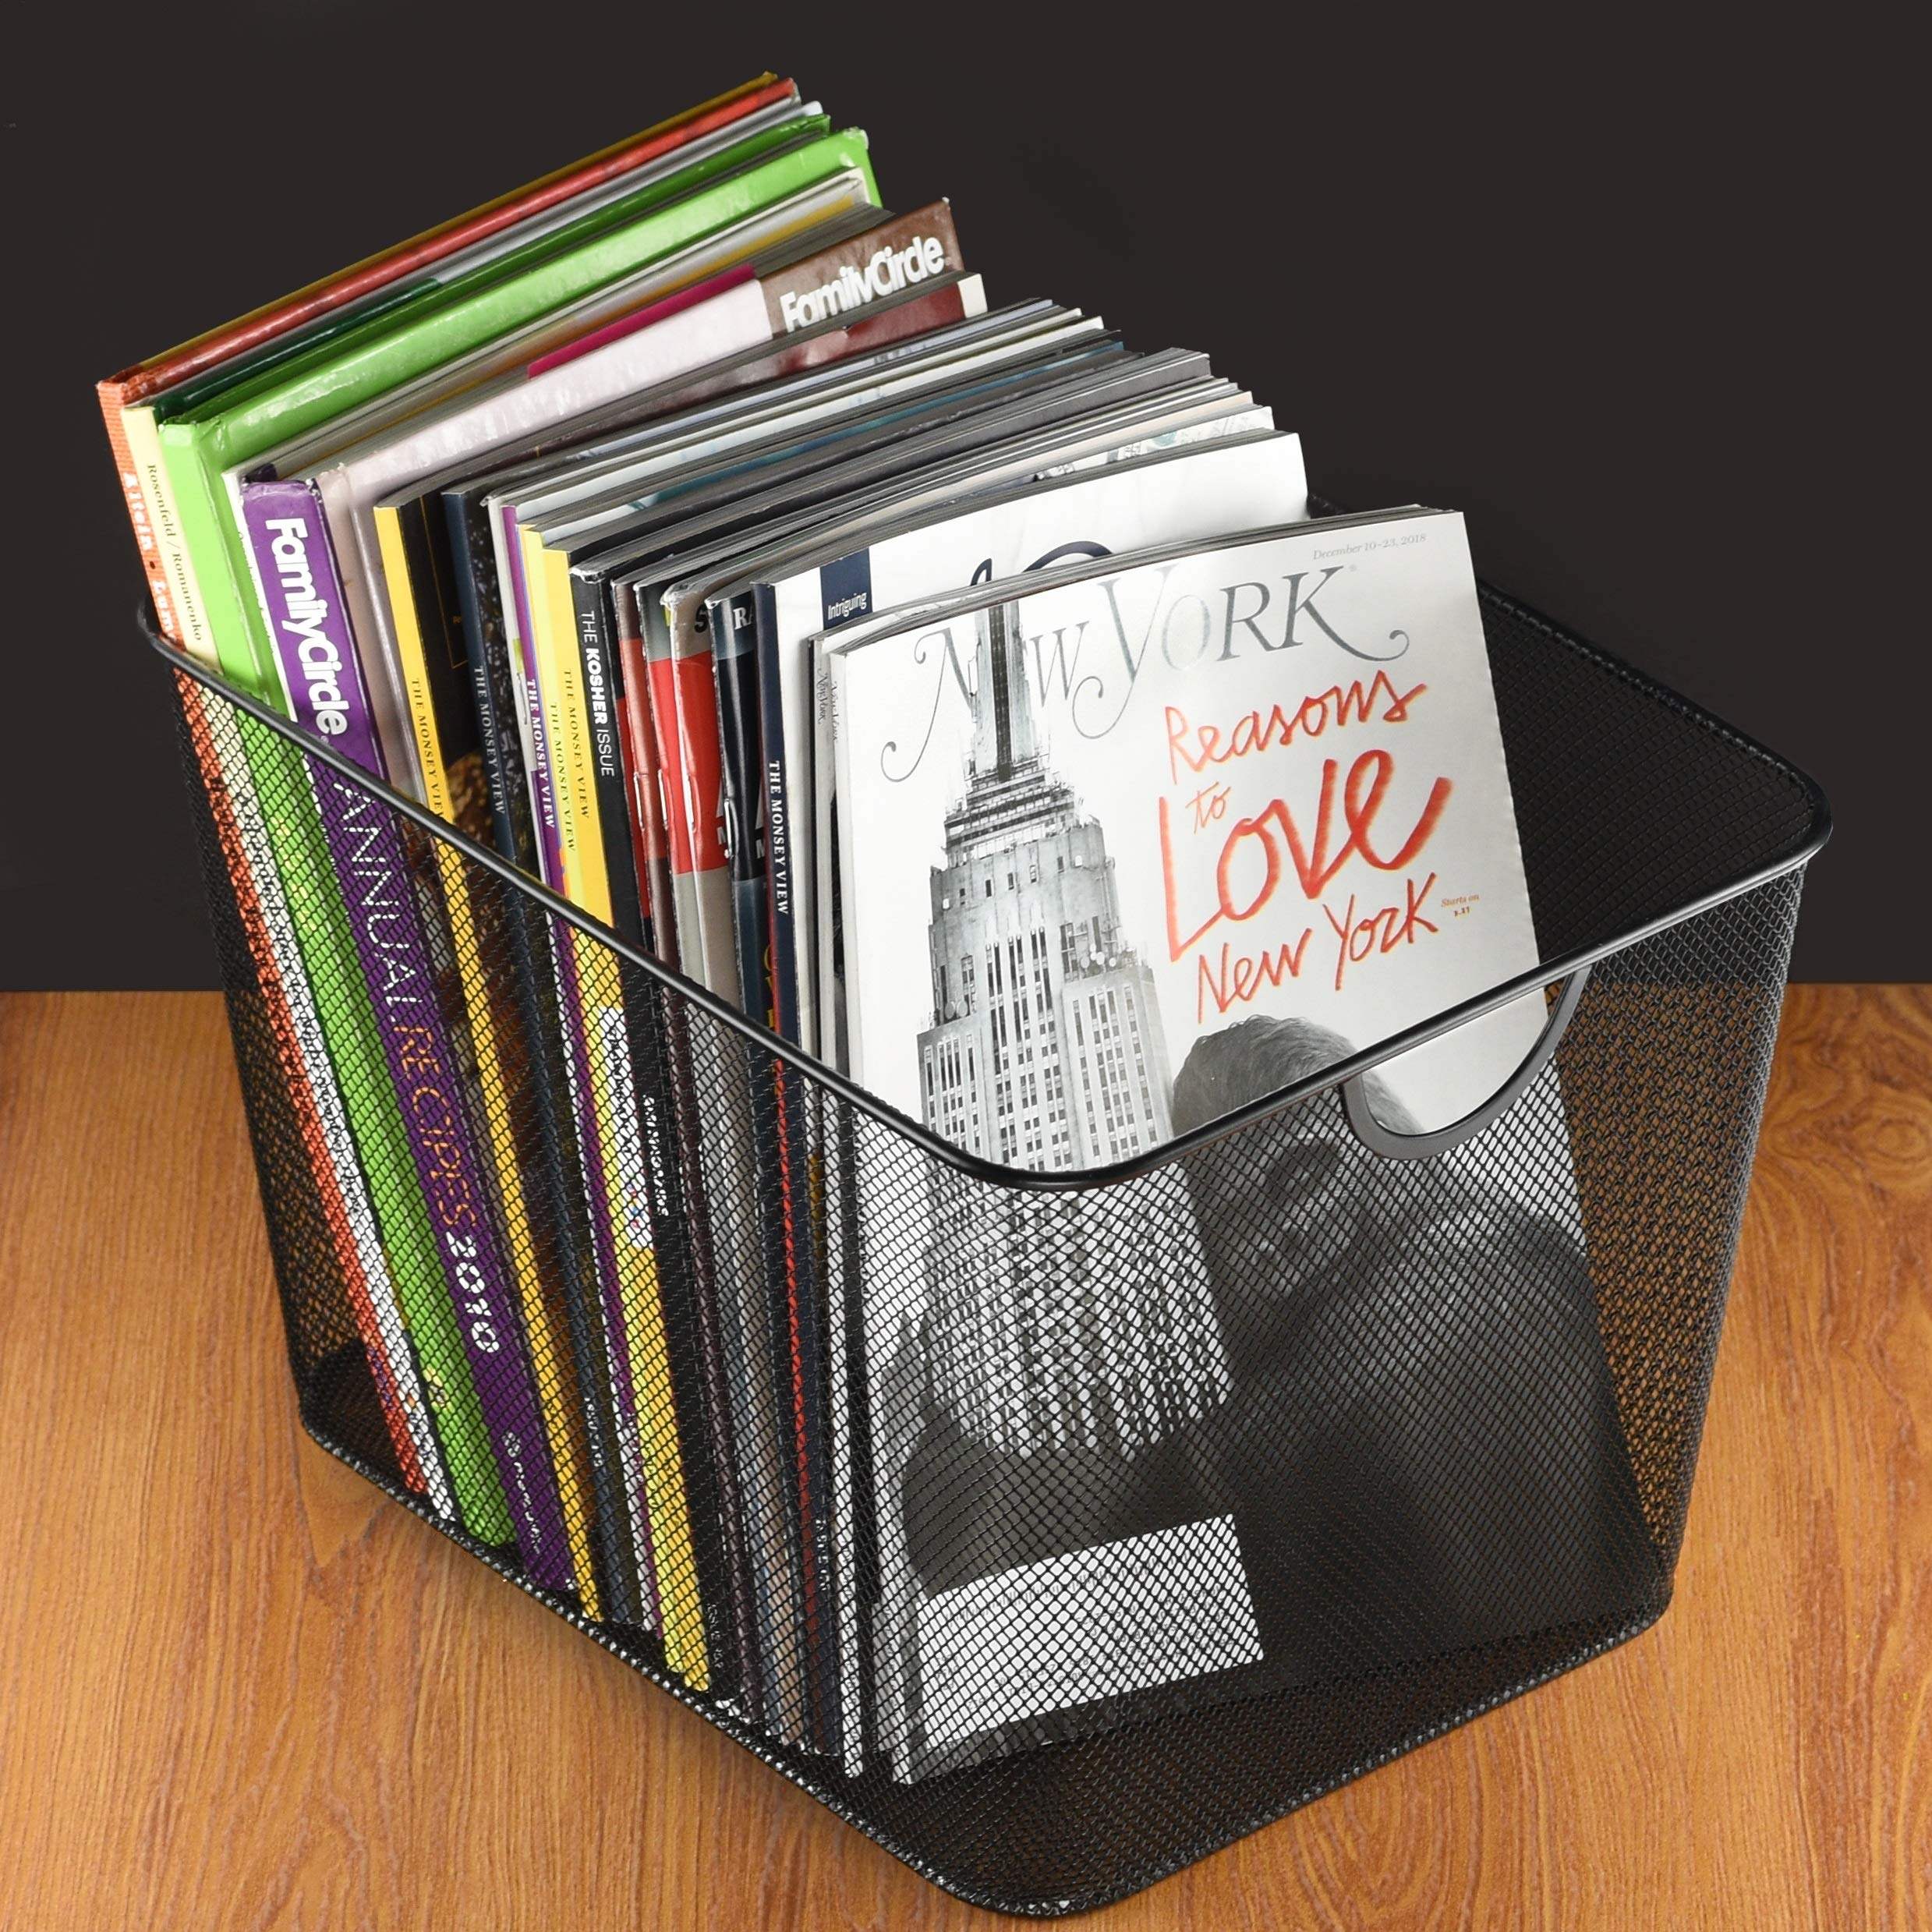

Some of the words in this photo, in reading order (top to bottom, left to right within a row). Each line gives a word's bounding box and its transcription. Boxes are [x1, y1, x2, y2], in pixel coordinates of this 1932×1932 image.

[147, 464, 176, 537] Rosenfeld
[172, 553, 201, 641] Romanenko
[1313, 544, 1363, 561] December
[1364, 537, 1400, 553] 10-23,
[1401, 533, 1427, 546] 2018
[265, 518, 349, 735] FamilyCircle
[580, 611, 598, 643] THE
[827, 592, 867, 621] Intriguing
[411, 678, 425, 710] THE
[474, 667, 487, 698] THE
[527, 679, 539, 712] THE
[564, 669, 575, 700] THE
[586, 647, 609, 725] KOSHER
[479, 703, 498, 766] MONSEY
[550, 702, 561, 734] THE
[568, 706, 584, 773] MONSEY
[1165, 670, 1428, 785] Reasons
[417, 715, 437, 778] MONSEY
[532, 717, 548, 782] MONSEY
[596, 729, 614, 777] ISSUE
[490, 773, 505, 814] VIEW
[554, 740, 570, 805] MONSEY
[769, 760, 782, 794] THE
[540, 784, 555, 829] VIEW
[577, 777, 589, 819] VIEW
[1185, 782, 1232, 834] to
[564, 811, 575, 851] VIEW
[771, 799, 786, 867] MONSEY
[775, 869, 789, 915] VIEW
[1198, 928, 1313, 1024] New
[1322, 872, 1439, 990] York
[334, 782, 423, 1022] ANNUAL
[445, 1231, 500, 1353] 2010
